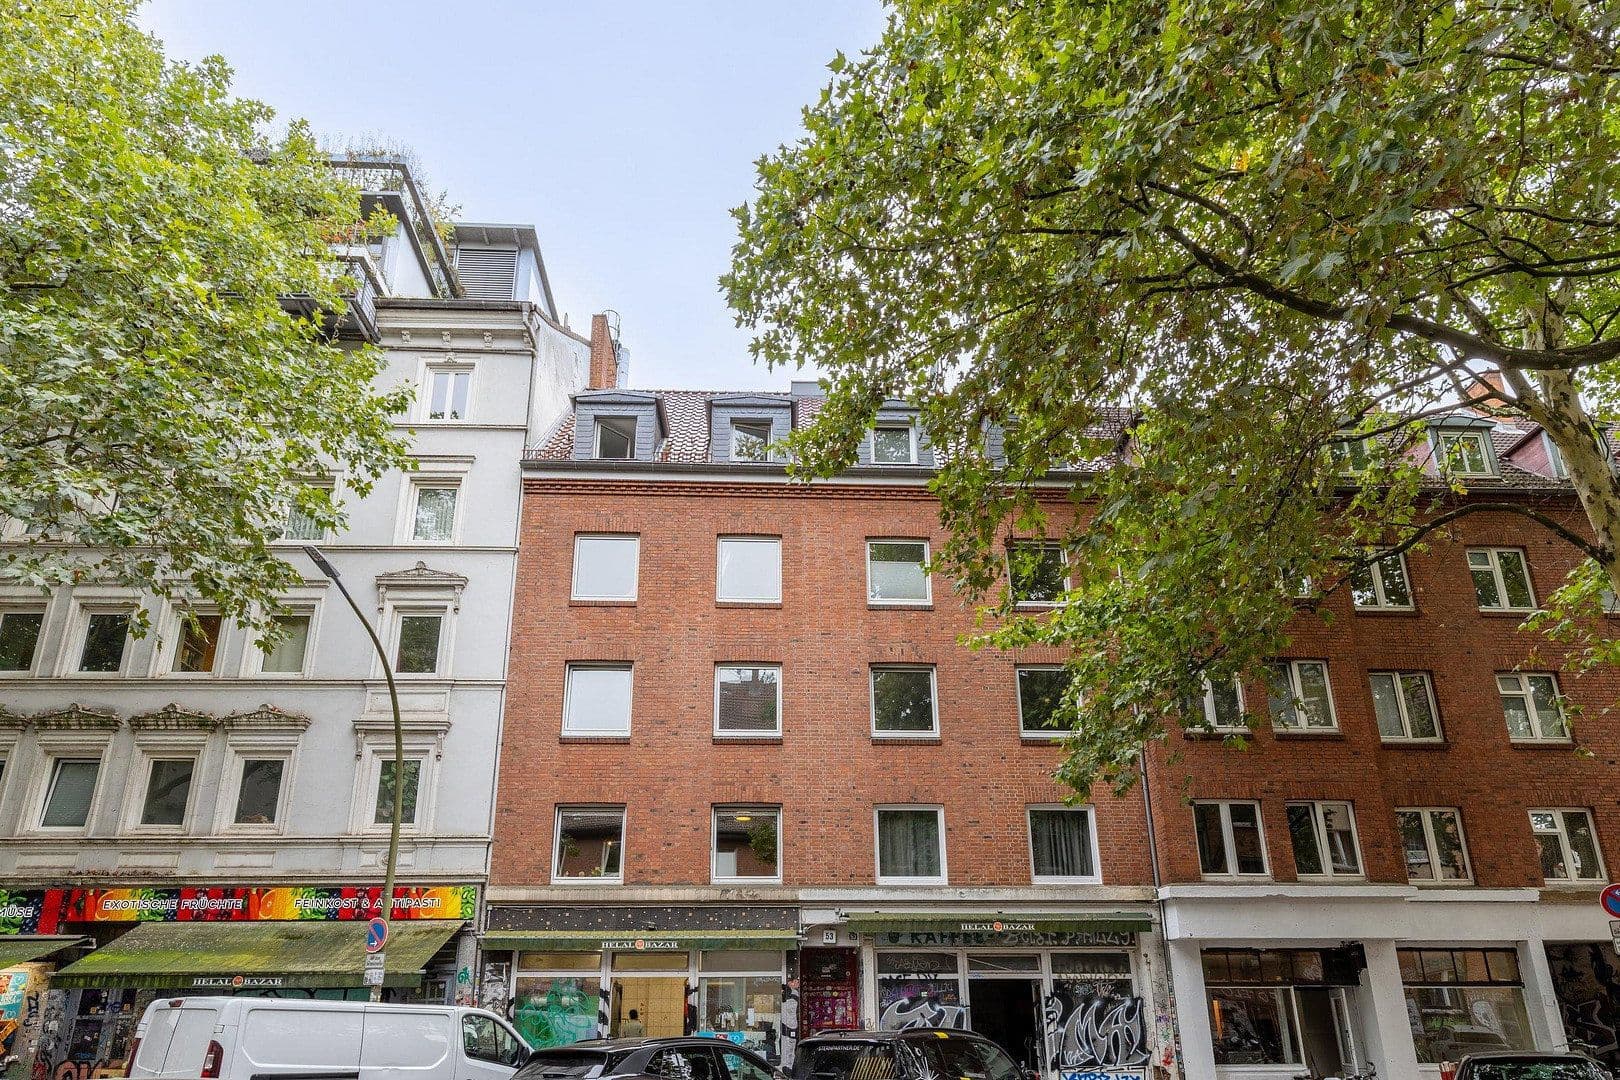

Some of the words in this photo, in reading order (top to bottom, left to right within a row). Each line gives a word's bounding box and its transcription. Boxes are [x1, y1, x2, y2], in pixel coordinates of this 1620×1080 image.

[103, 898, 178, 910] EXOTISCHE
[181, 897, 244, 910] FRÜCHTE
[294, 897, 358, 909] FEINKOST
[362, 898, 371, 909] &
[373, 897, 442, 909] ATIPASTI
[960, 922, 993, 931] HELAL
[1003, 922, 1036, 931] BAZAR
[825, 932, 834, 941] 53
[601, 941, 635, 949] HELAL
[645, 941, 679, 949] BAZAR
[192, 977, 232, 986] HELAL
[244, 977, 283, 986] BAZAR
